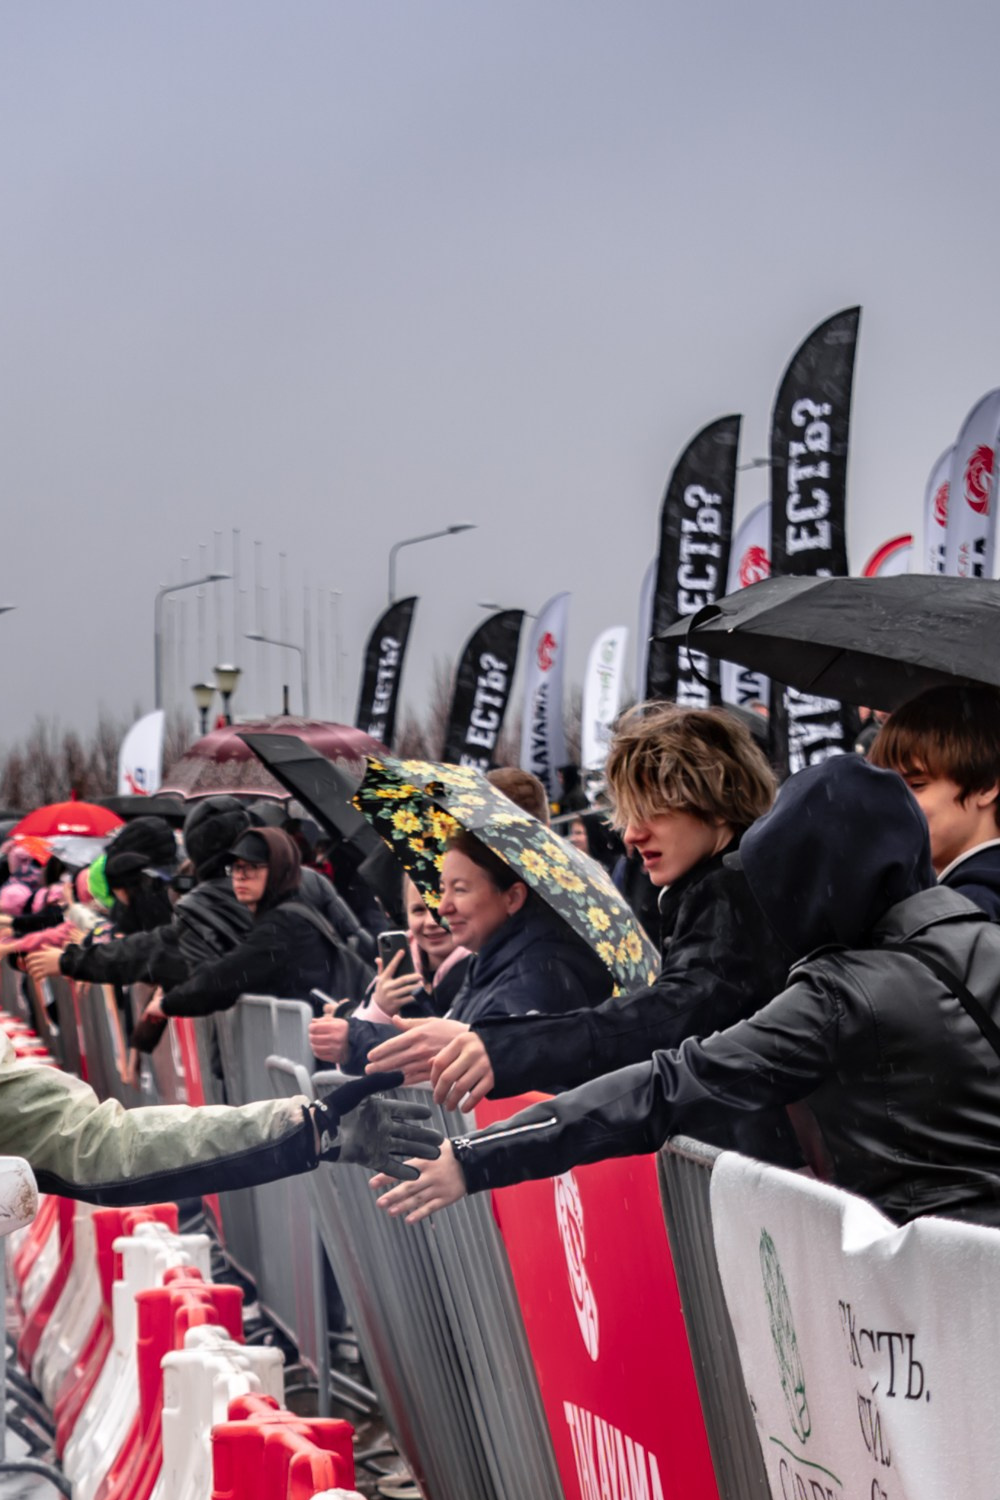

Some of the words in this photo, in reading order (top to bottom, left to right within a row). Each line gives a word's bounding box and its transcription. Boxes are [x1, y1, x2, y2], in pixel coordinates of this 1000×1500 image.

[786, 397, 832, 556] ЕСТЬ?
[677, 484, 722, 616] ЕСТЬ?
[371, 636, 401, 715] ЕСТЬ?
[465, 652, 508, 750] ЕСТЬ?
